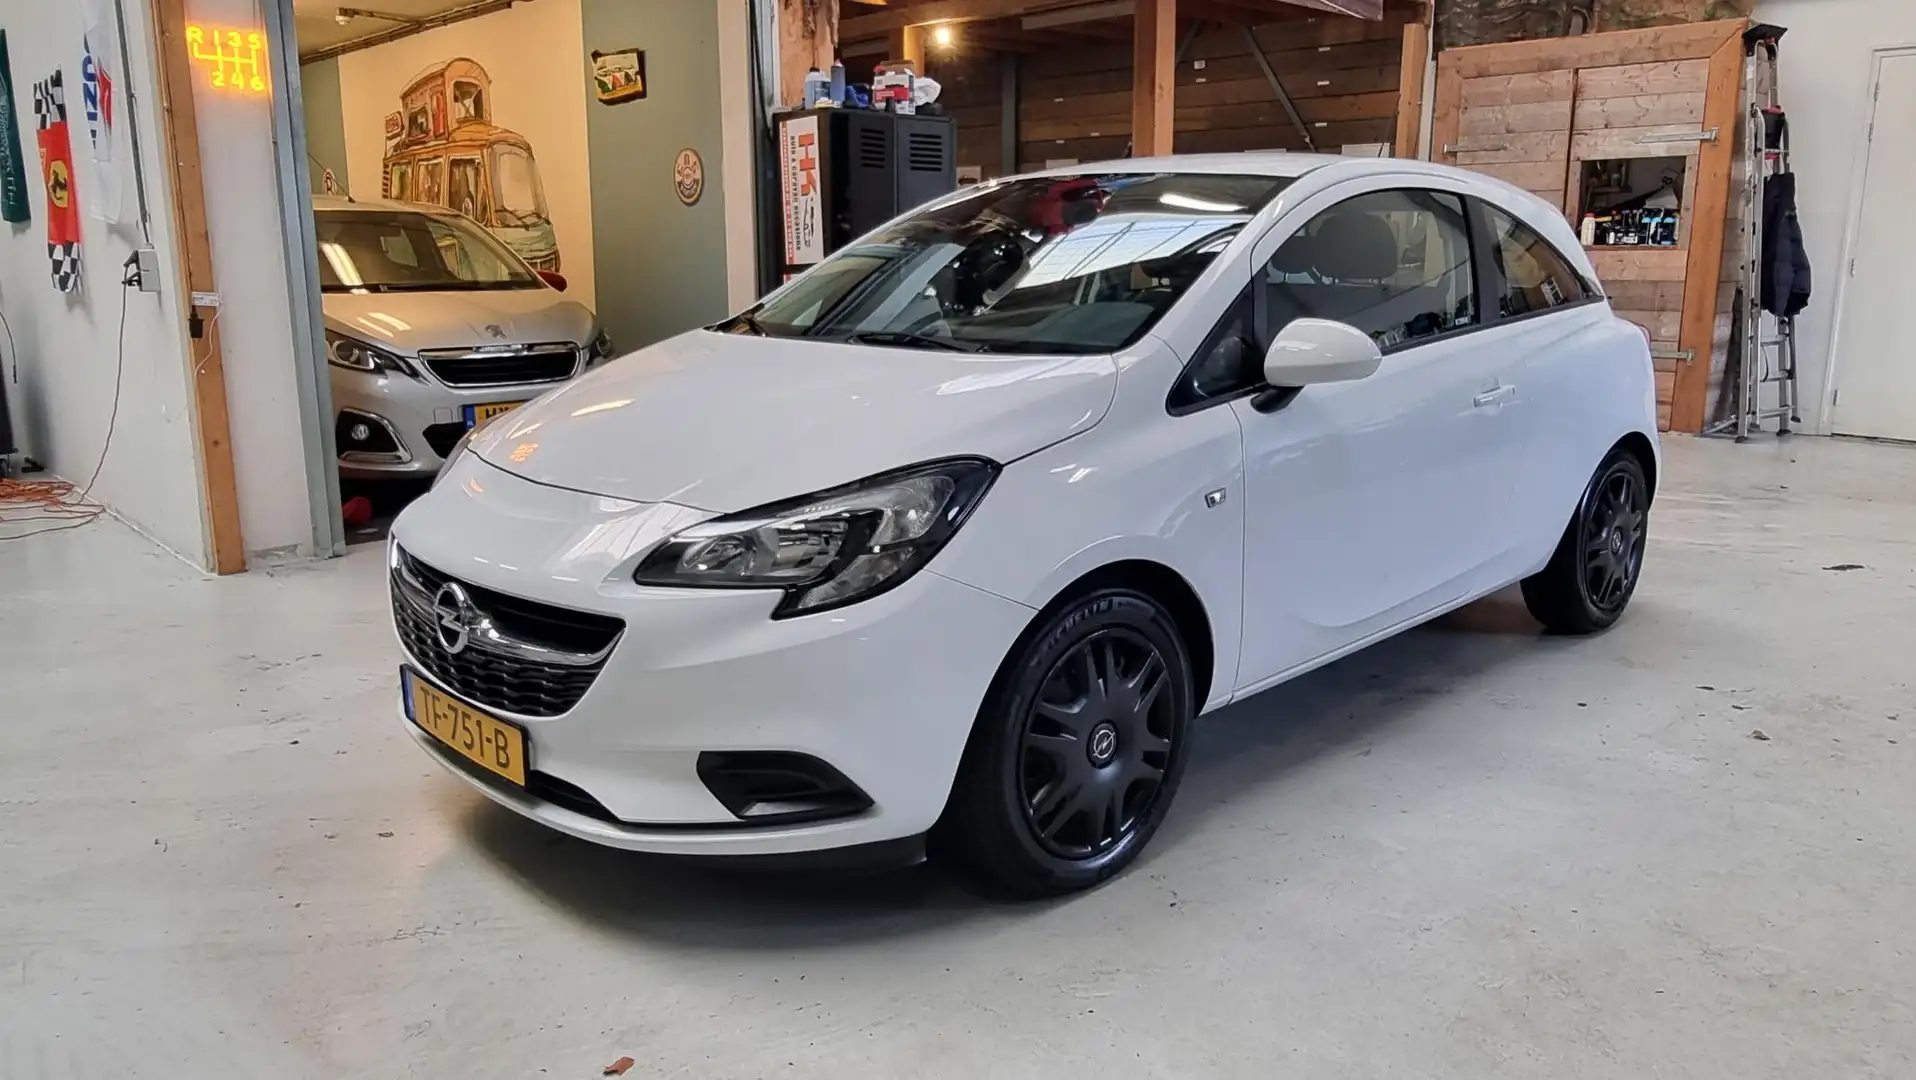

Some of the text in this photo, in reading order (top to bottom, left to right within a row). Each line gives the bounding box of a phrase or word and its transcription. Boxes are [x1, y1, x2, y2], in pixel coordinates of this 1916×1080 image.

[186, 26, 204, 44] R
[227, 31, 243, 48] 3
[247, 33, 262, 50] 5
[211, 71, 265, 92] 2 4 6
[798, 133, 817, 196] HK
[794, 205, 802, 251] occasions
[420, 686, 510, 769] TF-751-B
